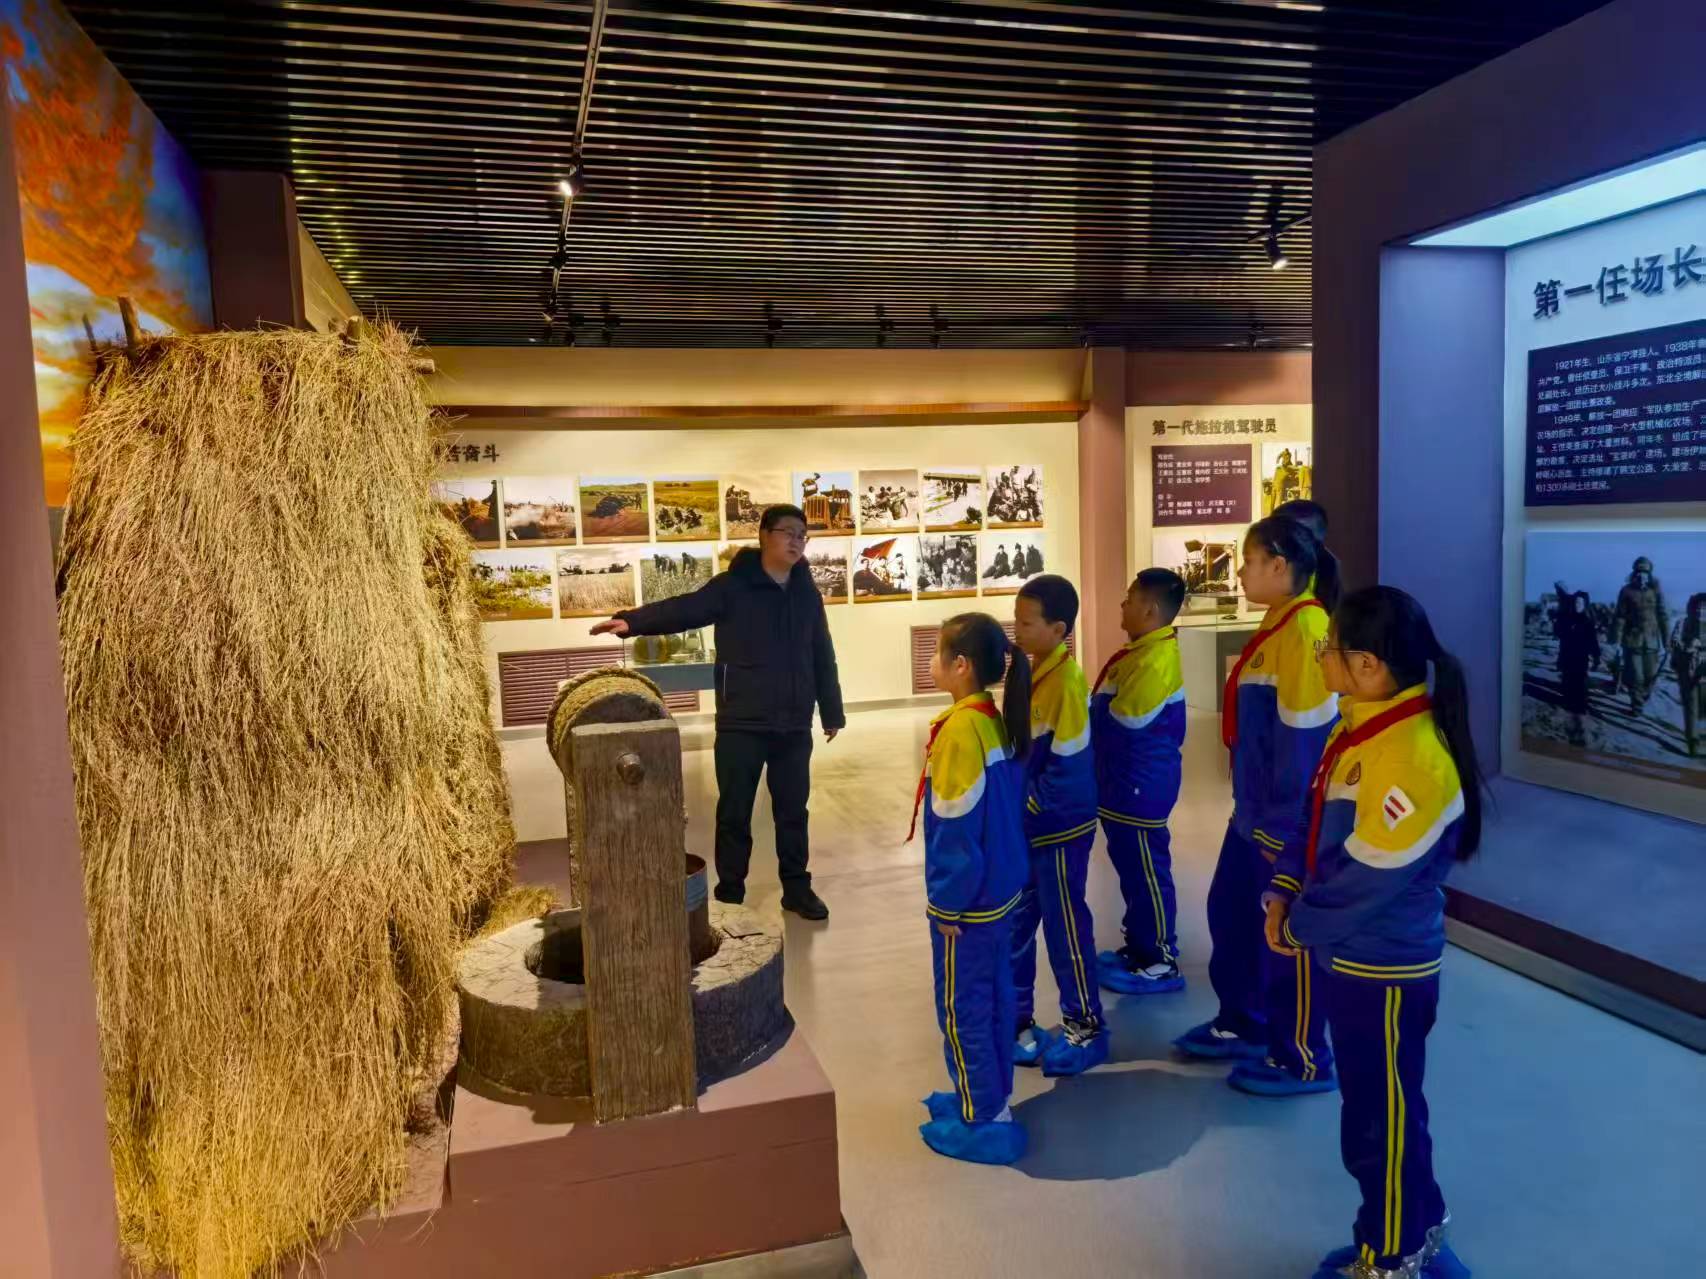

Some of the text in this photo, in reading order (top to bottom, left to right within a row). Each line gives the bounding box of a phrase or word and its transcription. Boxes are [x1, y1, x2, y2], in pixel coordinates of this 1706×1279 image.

[1533, 244, 1706, 319] 第一任场长
[1152, 418, 1277, 435] 第一代拖拉机驾驶员
